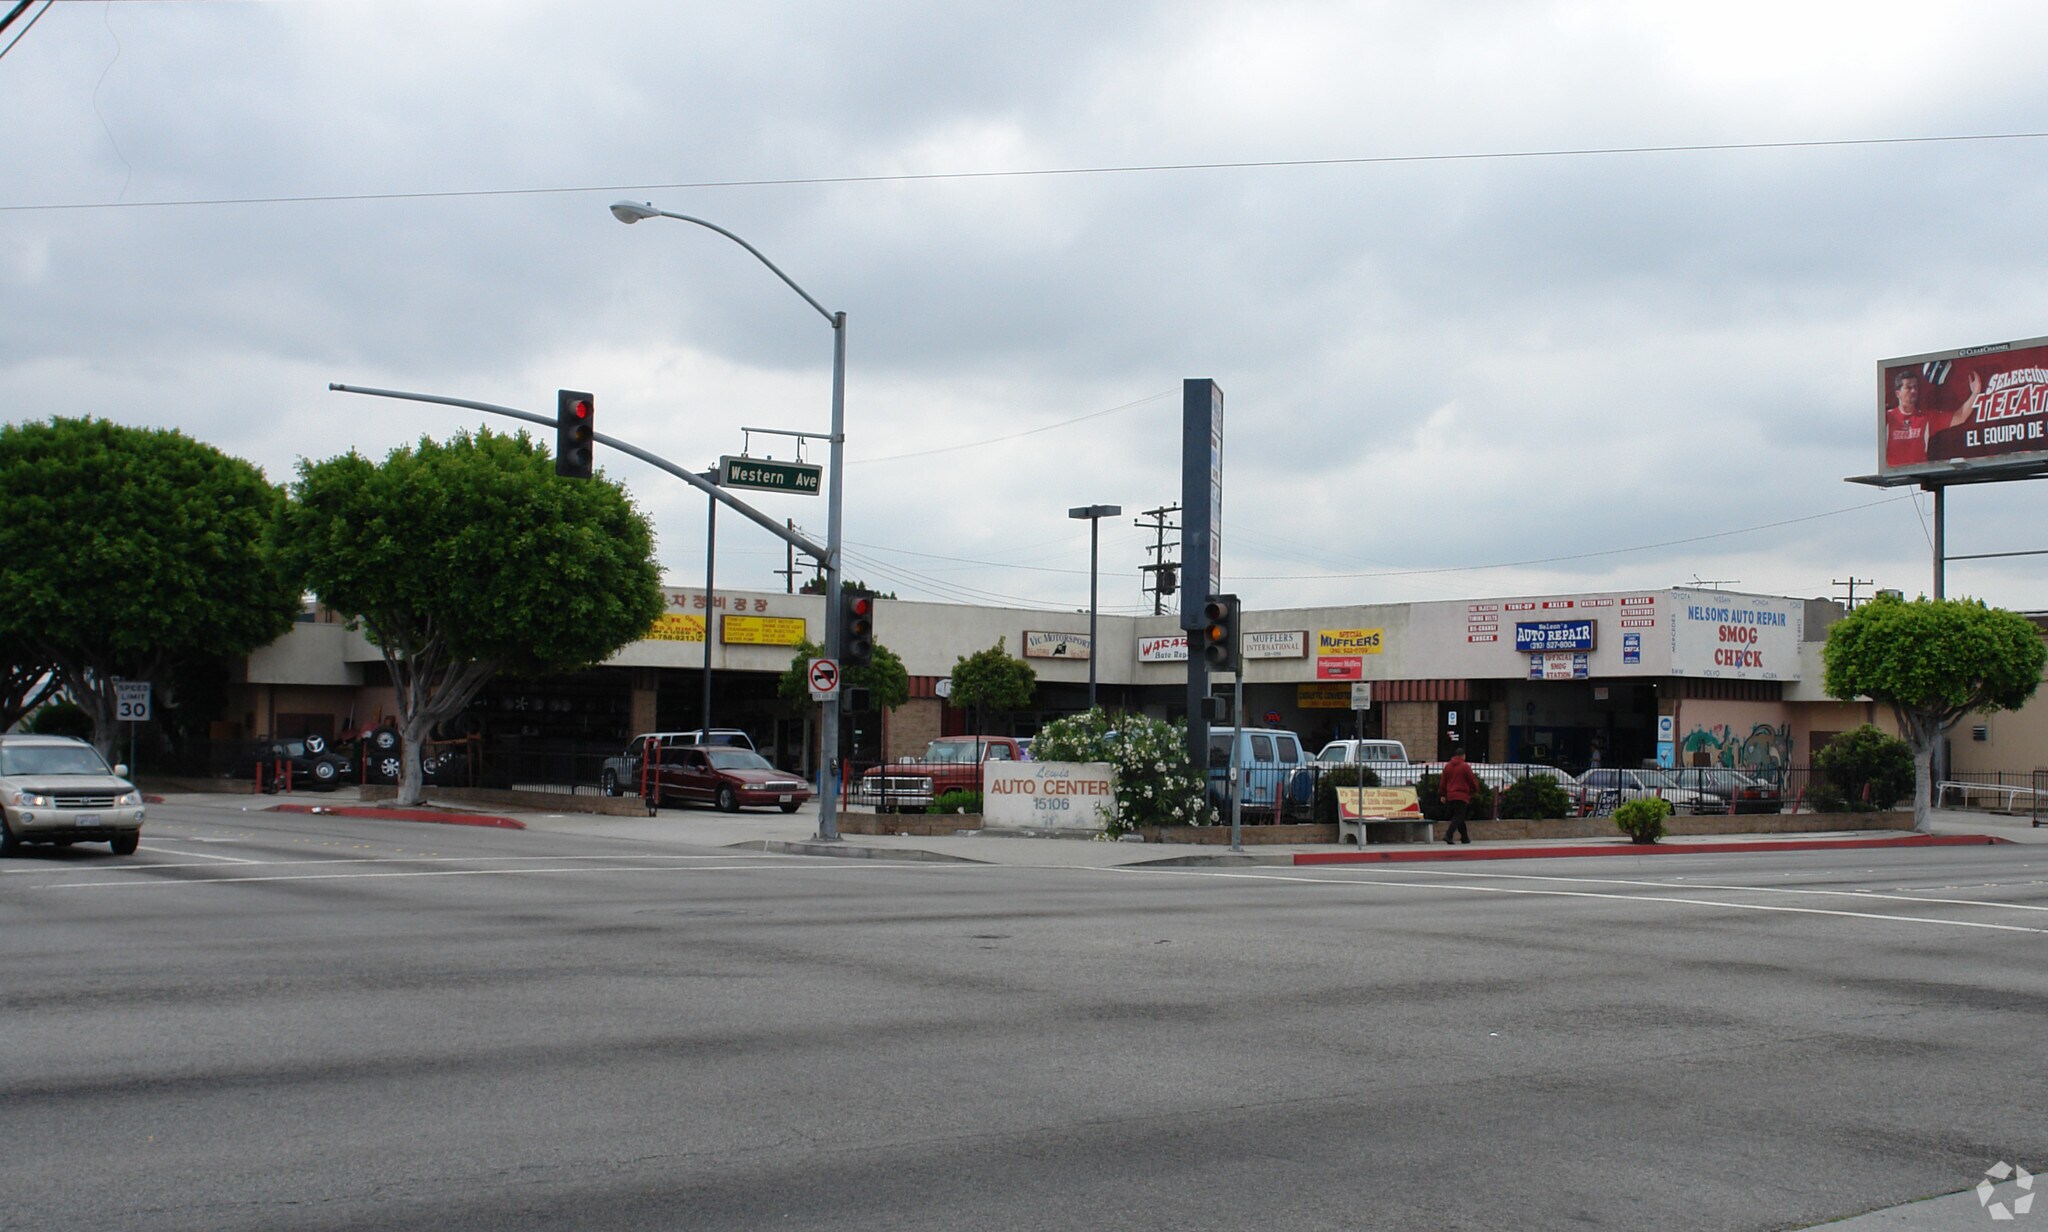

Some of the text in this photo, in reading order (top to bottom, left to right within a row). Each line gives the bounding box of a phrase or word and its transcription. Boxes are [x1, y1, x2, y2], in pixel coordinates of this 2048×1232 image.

[1971, 383, 2048, 424] TECAT
[1966, 420, 2044, 447] EL EQUIPO DE
[730, 465, 817, 487] Western Ave
[1671, 591, 1691, 600] TOYOTA
[1688, 605, 1786, 627] NELSON'S AUTO REPAIR
[1252, 633, 1293, 643] MUFFLERS
[1320, 632, 1380, 647] MUFFLERS
[1517, 625, 1591, 642] AUTO REPAIR
[1718, 624, 1758, 644] SMOG
[1246, 643, 1299, 652] INTERNATIONAL
[1714, 647, 1763, 668] CHECK
[1550, 662, 1567, 670] SMOG
[1546, 671, 1571, 679] STATION
[120, 702, 146, 717] 30
[1034, 765, 1070, 779] Lewis
[991, 779, 1109, 795] AUTO CENTER
[1033, 797, 1070, 811] 15106
